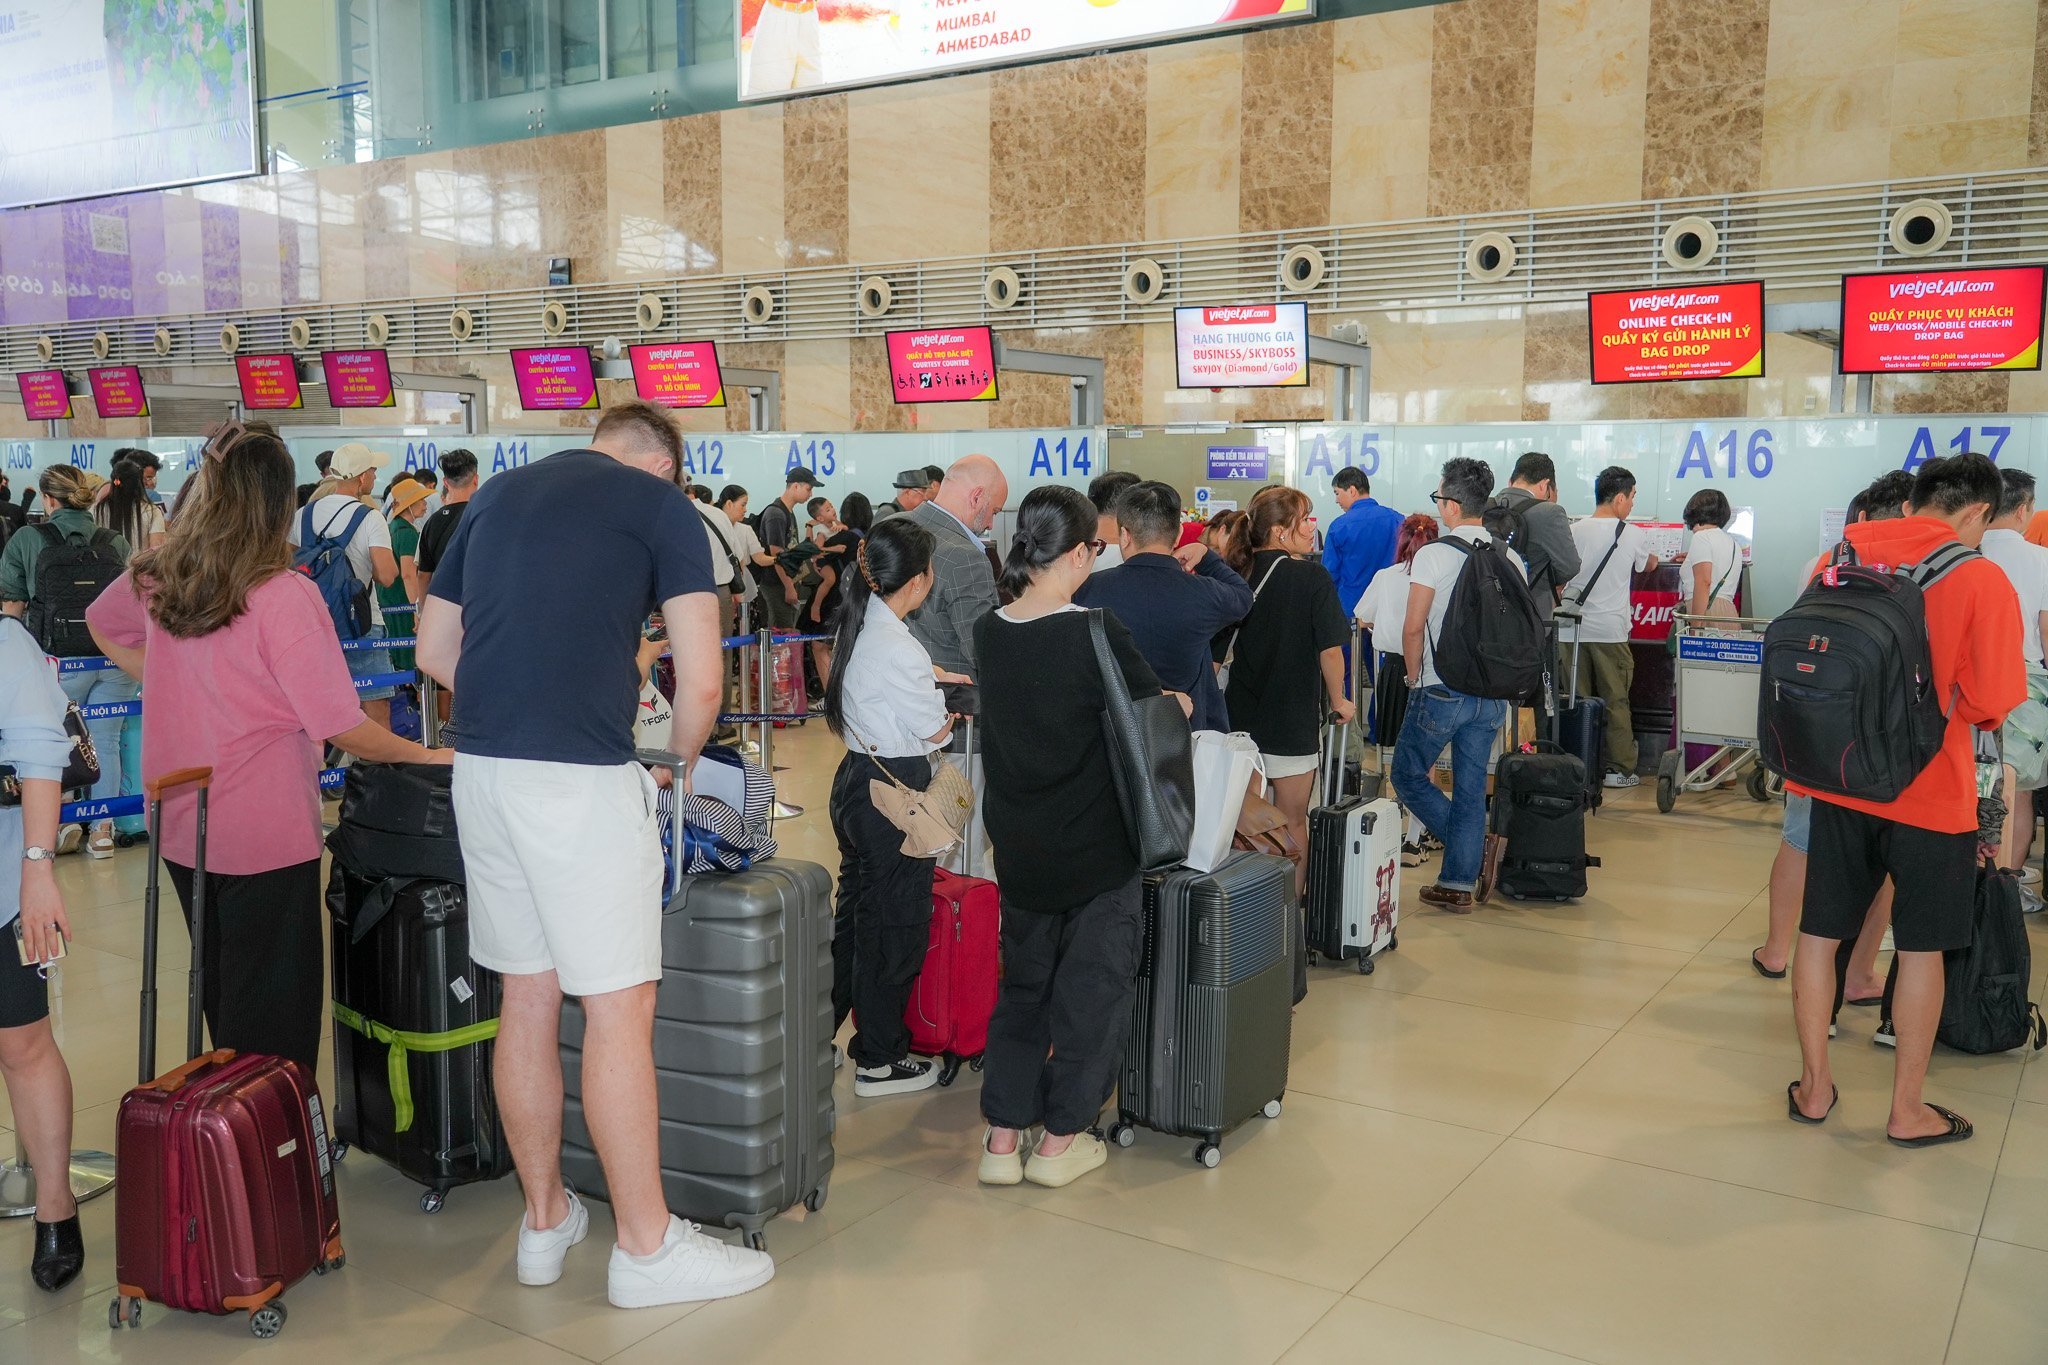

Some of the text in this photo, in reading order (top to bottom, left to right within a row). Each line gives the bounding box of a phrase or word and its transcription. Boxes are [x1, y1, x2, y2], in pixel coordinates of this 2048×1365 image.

[936, 11, 996, 32] MUMBAI
[936, 28, 1031, 54] AHMEDABAD
[1619, 312, 1732, 329] ONLINE CHECK-IN
[1908, 309, 1942, 322] PHỤC
[1946, 309, 1964, 321] VỤ
[1968, 305, 2014, 318] KHÁCH
[1602, 324, 1751, 347] QUẦY KÝ GỬI HÀNH LÝ
[1869, 320, 2013, 333] WEB/KIOSK/MOBILE CHECK-IN
[1193, 334, 1223, 347] HẠNG
[1275, 332, 1295, 342] GIA
[1193, 347, 1295, 361] BUSINESS/SKYBOSS
[1641, 344, 1710, 358] BAG DROP
[1193, 362, 1297, 375] SKYJOY (Diamond/Gold)
[8, 444, 32, 469] A06
[70, 444, 96, 470] A07
[404, 442, 437, 473] A10
[492, 442, 528, 472] A11
[683, 440, 724, 474] A12
[785, 440, 836, 476] A13
[1029, 436, 1092, 476] A14
[1304, 432, 1380, 476] A15
[1676, 428, 1774, 479] A16
[1901, 426, 2011, 472] A17
[1228, 468, 1248, 478] A1
[1711, 642, 1730, 650] 20.000
[91, 706, 108, 717] NỘI
[111, 704, 127, 714] BÀI
[641, 711, 671, 726] T-FORC
[320, 772, 340, 785] NỘI
[76, 804, 109, 817] N.I.A
